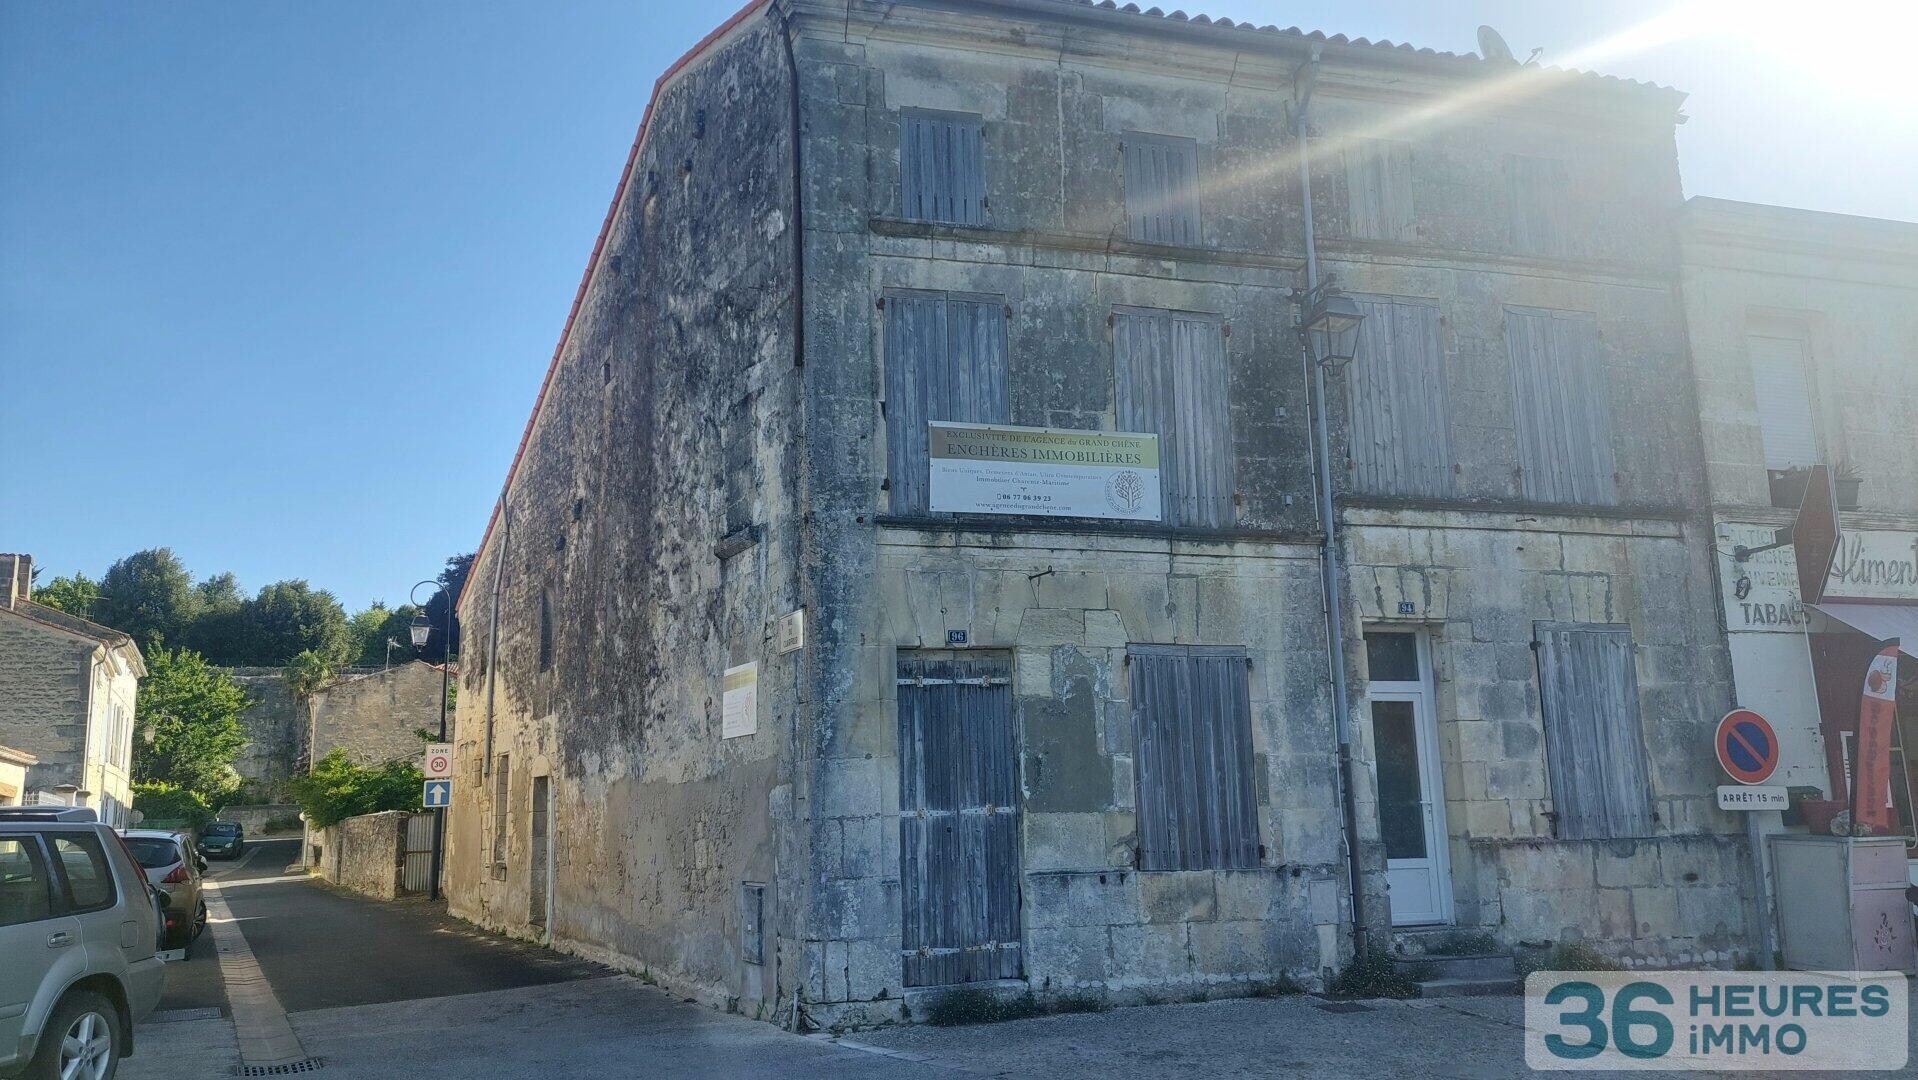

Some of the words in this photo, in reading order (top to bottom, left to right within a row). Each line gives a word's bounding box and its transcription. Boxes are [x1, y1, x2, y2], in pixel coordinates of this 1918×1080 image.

[1009, 434, 1021, 442] DE
[1067, 437, 1077, 445] du
[1079, 439, 1109, 447] GRAND
[1111, 439, 1141, 448] CHÊNE
[947, 443, 1028, 459] ENCHÈRES
[1033, 448, 1141, 464] IMMOBILIÈRES
[951, 631, 965, 641] 96
[1723, 791, 1753, 802] ARRÊT
[1757, 793, 1768, 802] 15
[1771, 794, 1785, 802] min
